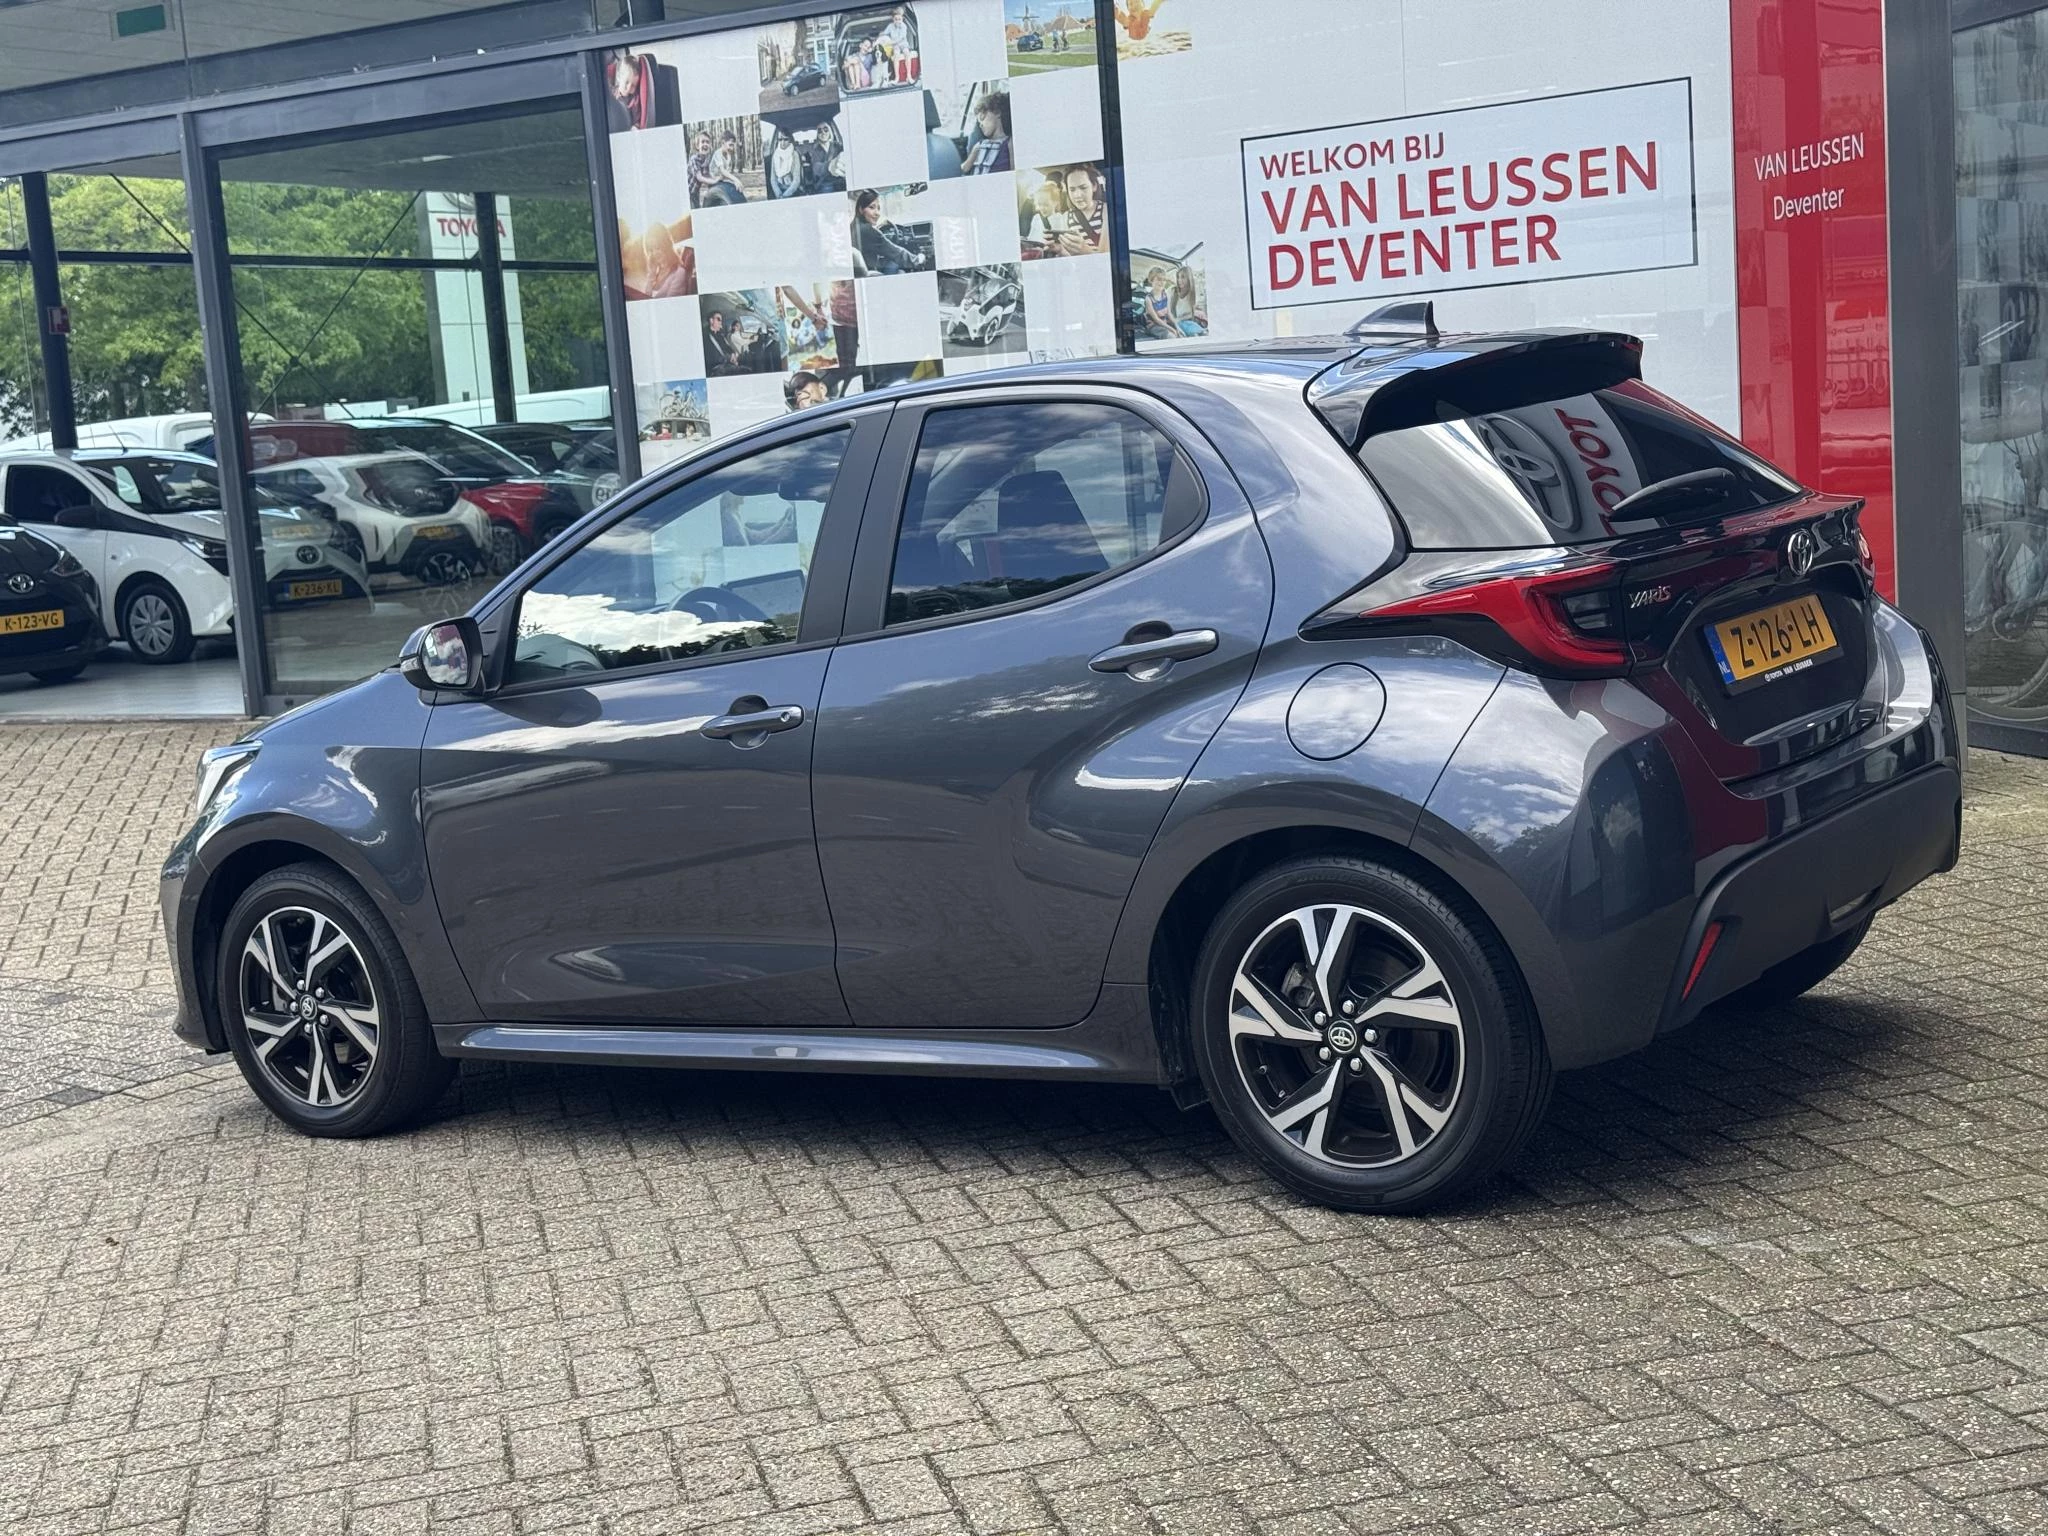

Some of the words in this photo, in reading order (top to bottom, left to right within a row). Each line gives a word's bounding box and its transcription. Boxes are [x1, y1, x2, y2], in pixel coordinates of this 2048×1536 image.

[1259, 138, 1394, 180] WELKOM
[1405, 132, 1445, 162] BIJ
[1754, 150, 1787, 181] VAN
[1791, 132, 1864, 173] LEUSSEN
[1261, 177, 1378, 235] VAN
[1398, 141, 1658, 221] LEUSSEN
[1773, 187, 1845, 221] Deventer
[436, 217, 506, 238] TOYA
[1268, 214, 1562, 291] DEVENTER
[4, 612, 59, 631] K-123-VG
[1730, 603, 1825, 669] Z-126-LH
[1718, 661, 1731, 674] NL
